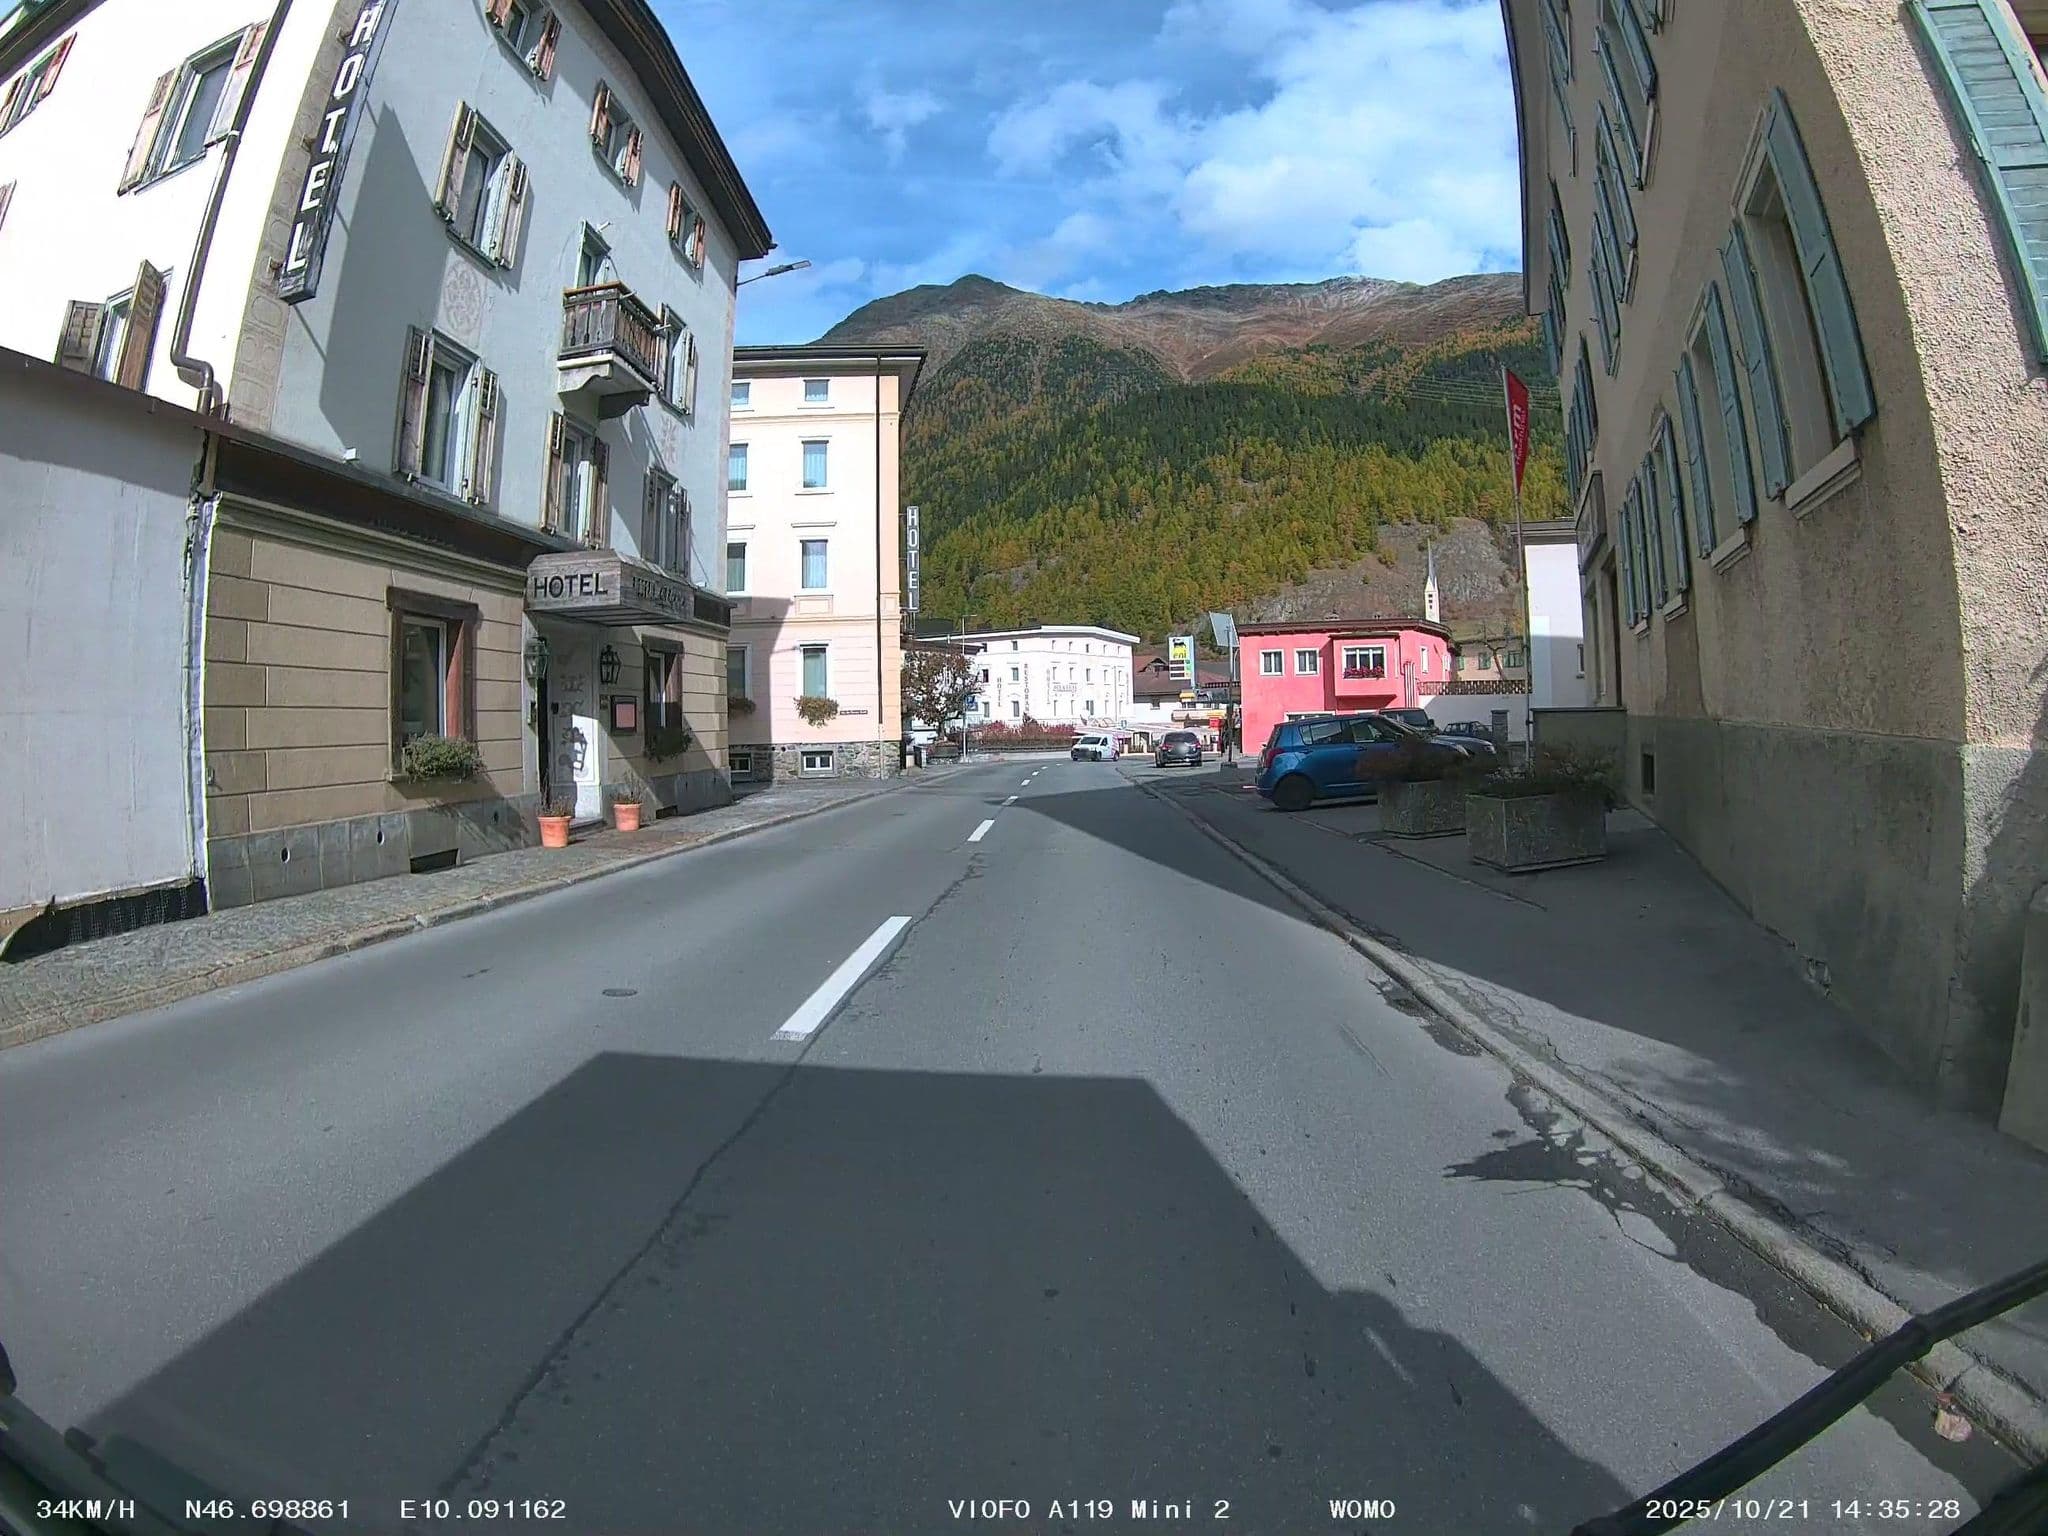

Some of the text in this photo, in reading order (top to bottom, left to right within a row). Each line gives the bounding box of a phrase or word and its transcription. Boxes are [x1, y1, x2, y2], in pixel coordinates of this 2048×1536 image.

[286, 9, 379, 275] HOTEL
[533, 572, 609, 599] HOTEL
[907, 507, 919, 611] HOTEL
